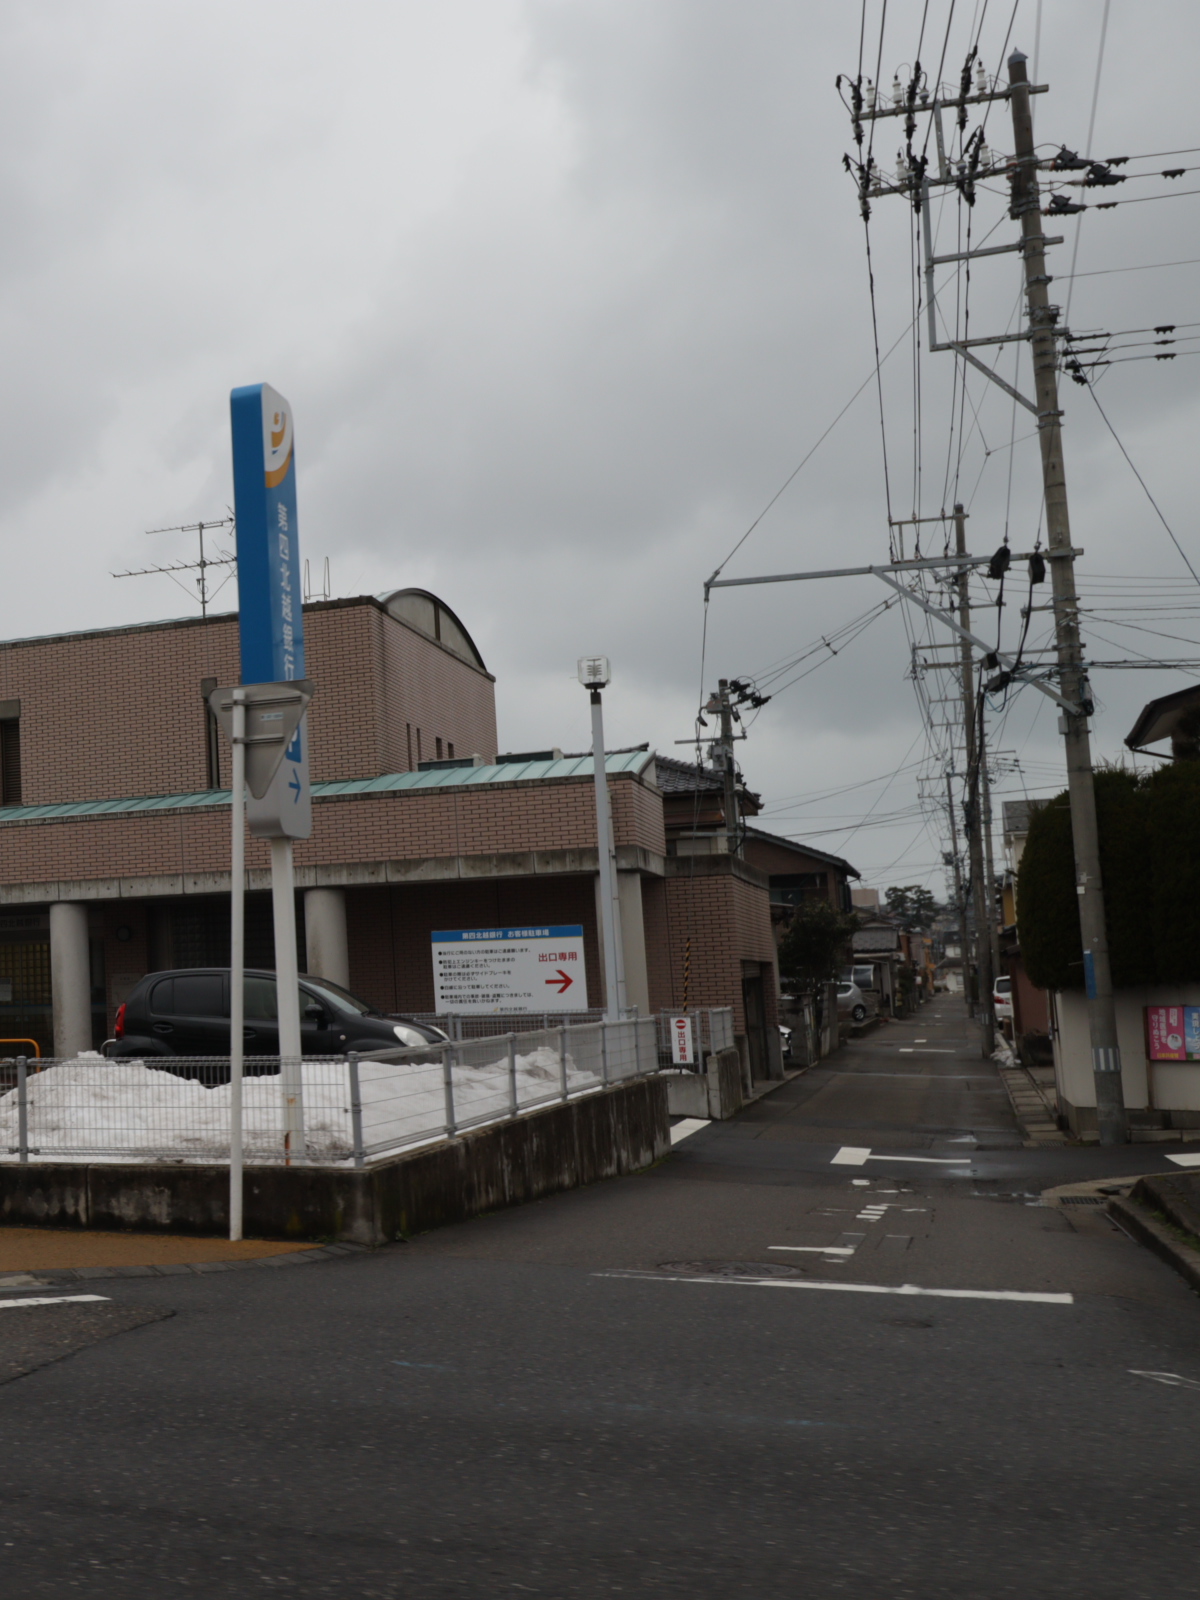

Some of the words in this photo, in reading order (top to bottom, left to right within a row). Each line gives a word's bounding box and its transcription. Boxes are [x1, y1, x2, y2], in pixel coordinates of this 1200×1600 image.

[461, 931, 503, 940] 第四北越銀行
[507, 929, 550, 938] お客様駐車場
[538, 951, 578, 963] 出口専用
[678, 1031, 687, 1061] 出口専用
